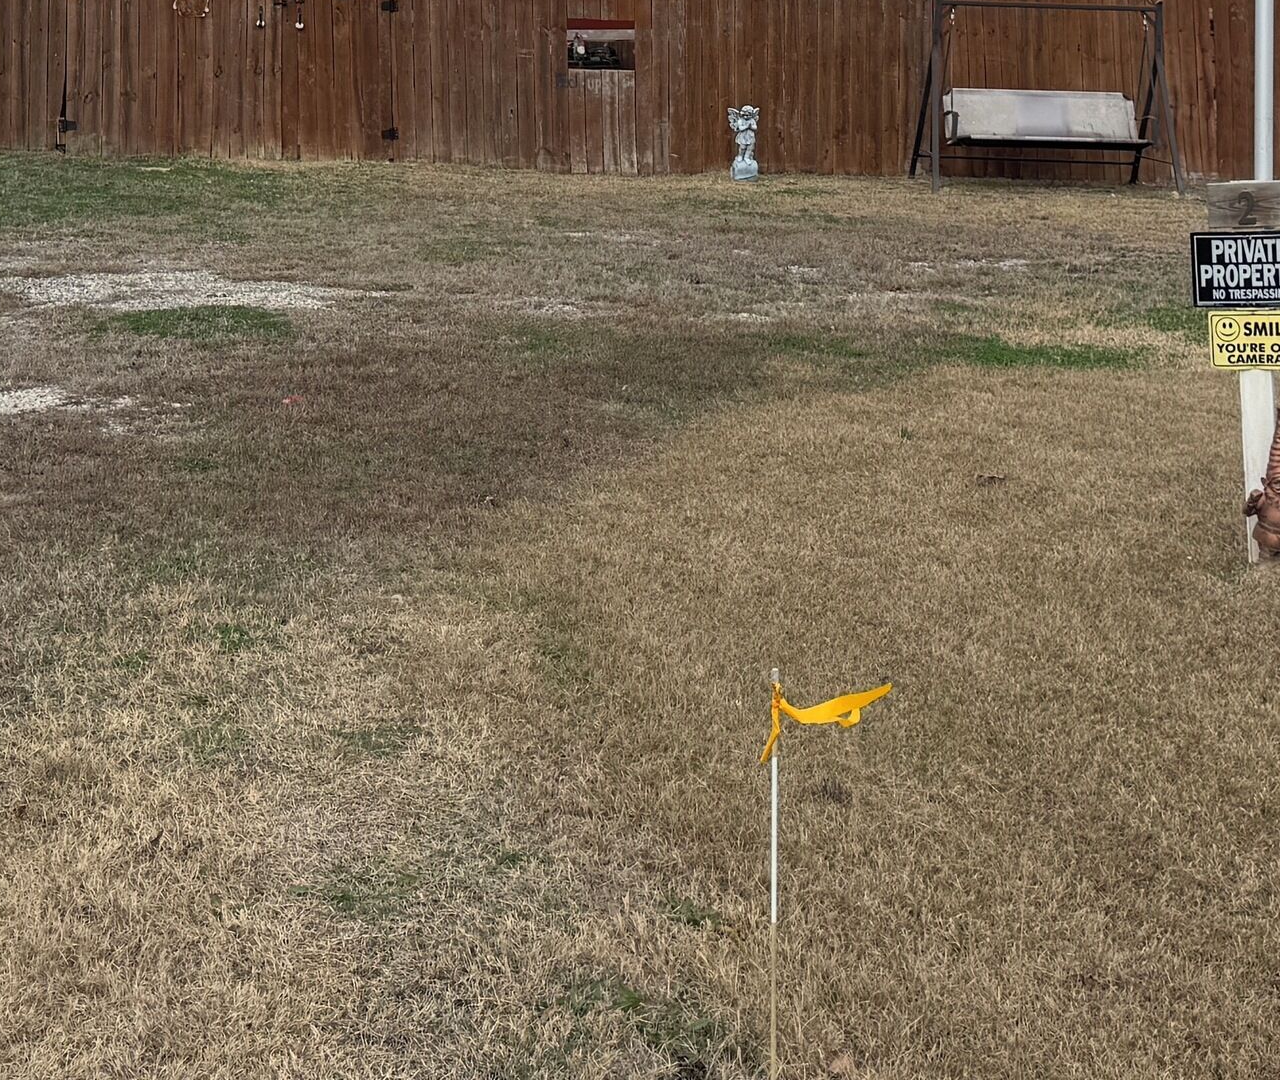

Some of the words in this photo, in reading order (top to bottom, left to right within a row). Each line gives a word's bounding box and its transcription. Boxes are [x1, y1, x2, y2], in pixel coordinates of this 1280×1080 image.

[1238, 191, 1257, 225] 2
[1213, 289, 1226, 299] NO
[1216, 343, 1266, 353] YOU'RE
